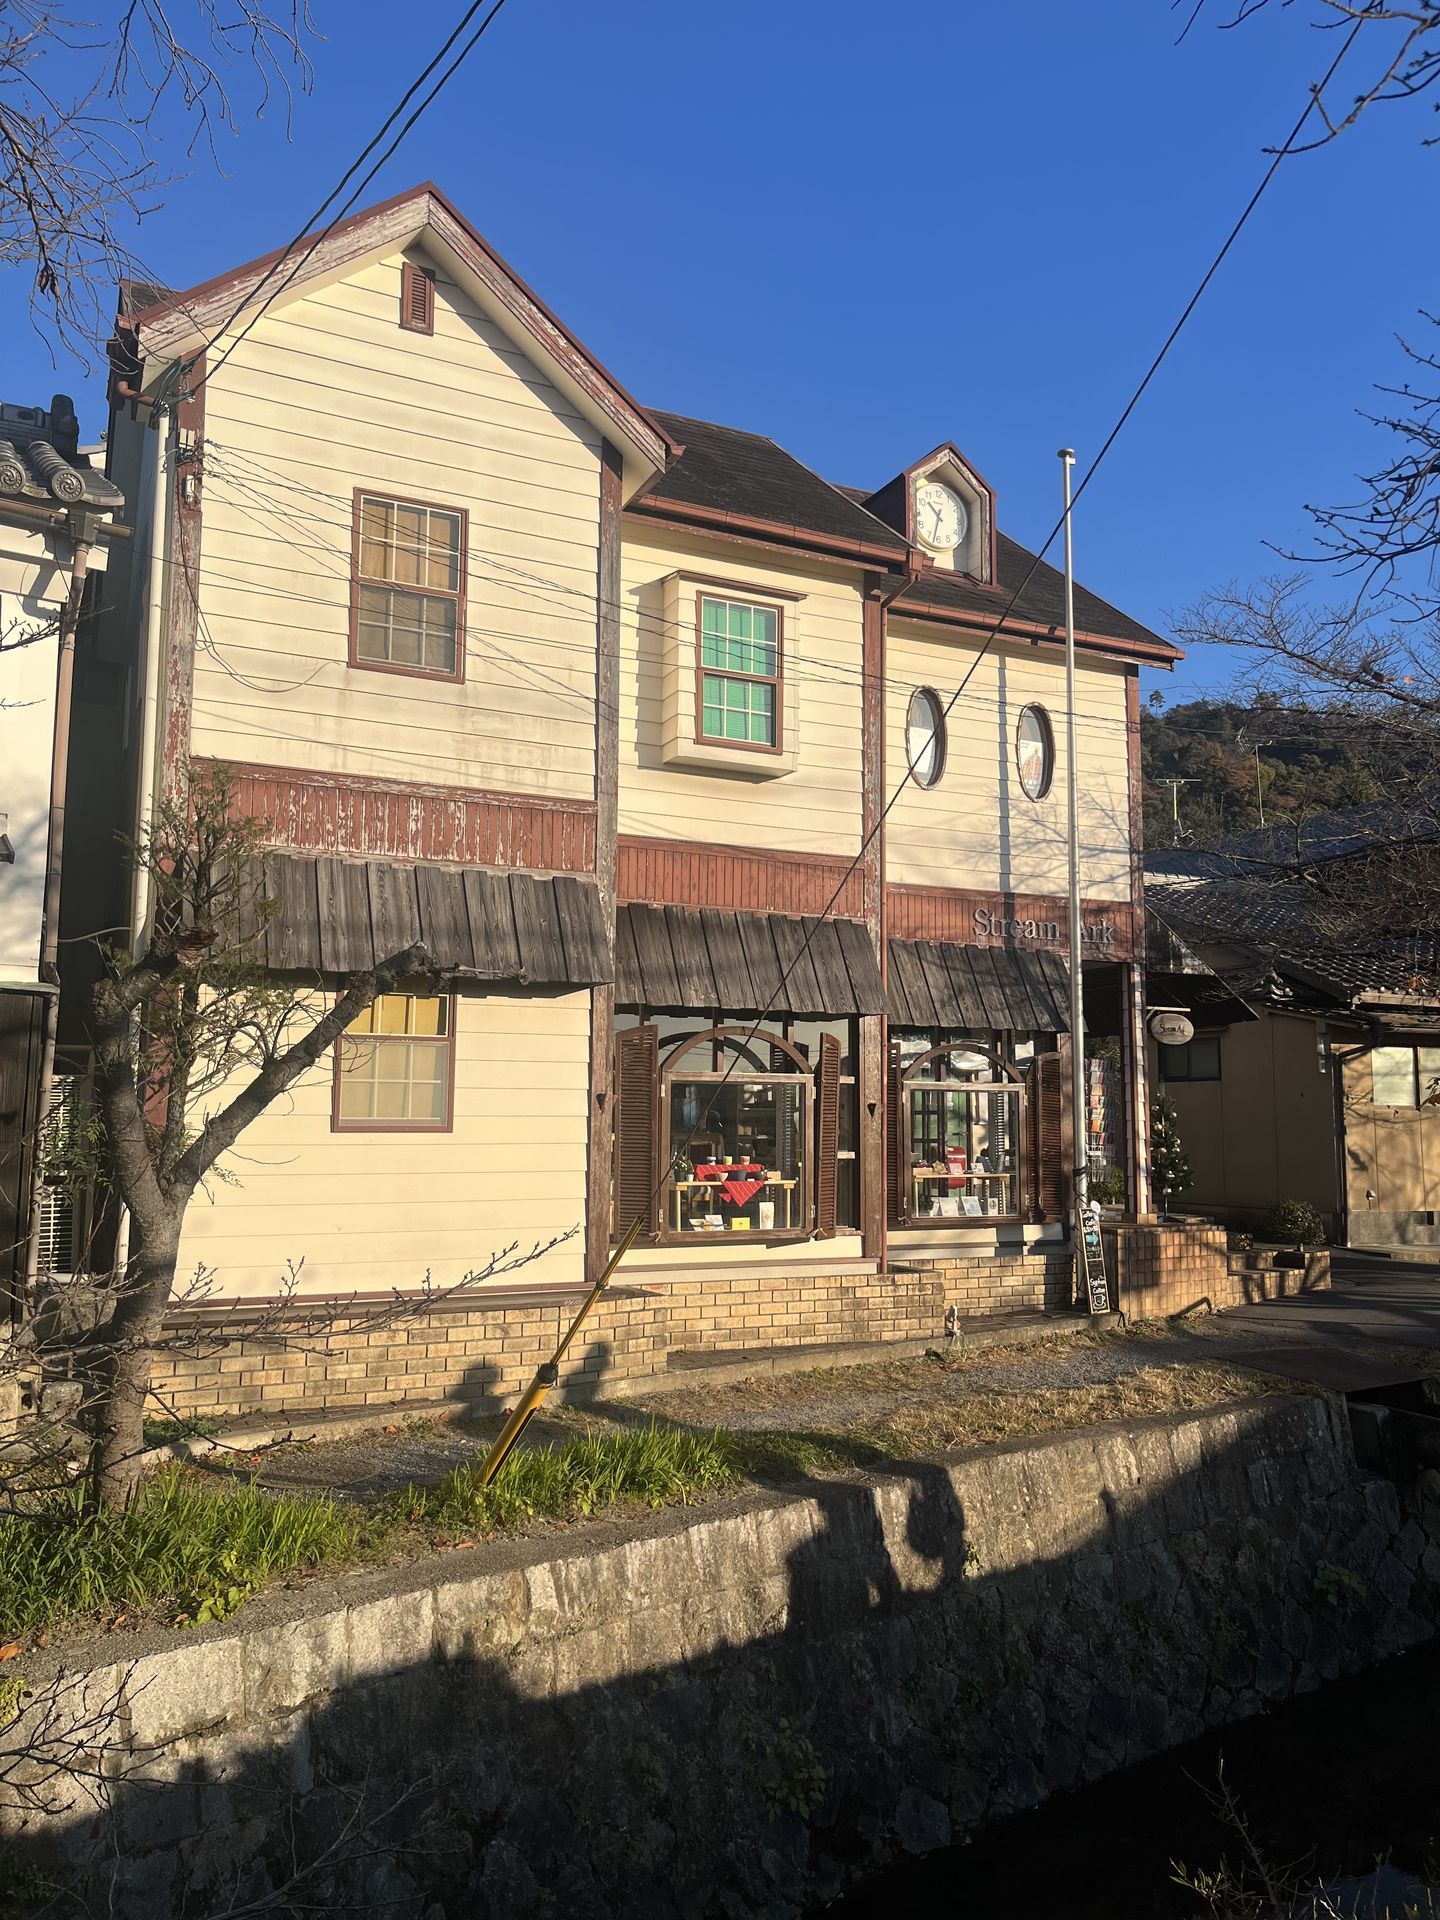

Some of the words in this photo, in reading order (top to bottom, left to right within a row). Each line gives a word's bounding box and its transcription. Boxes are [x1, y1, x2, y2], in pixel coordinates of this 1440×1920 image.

[925, 491, 932, 499] 11
[935, 489, 943, 498] 12
[918, 498, 926, 506] 10
[952, 504, 959, 512] 2
[936, 535, 942, 544] 6
[945, 534, 951, 543] 5
[973, 908, 1061, 940] Stream
